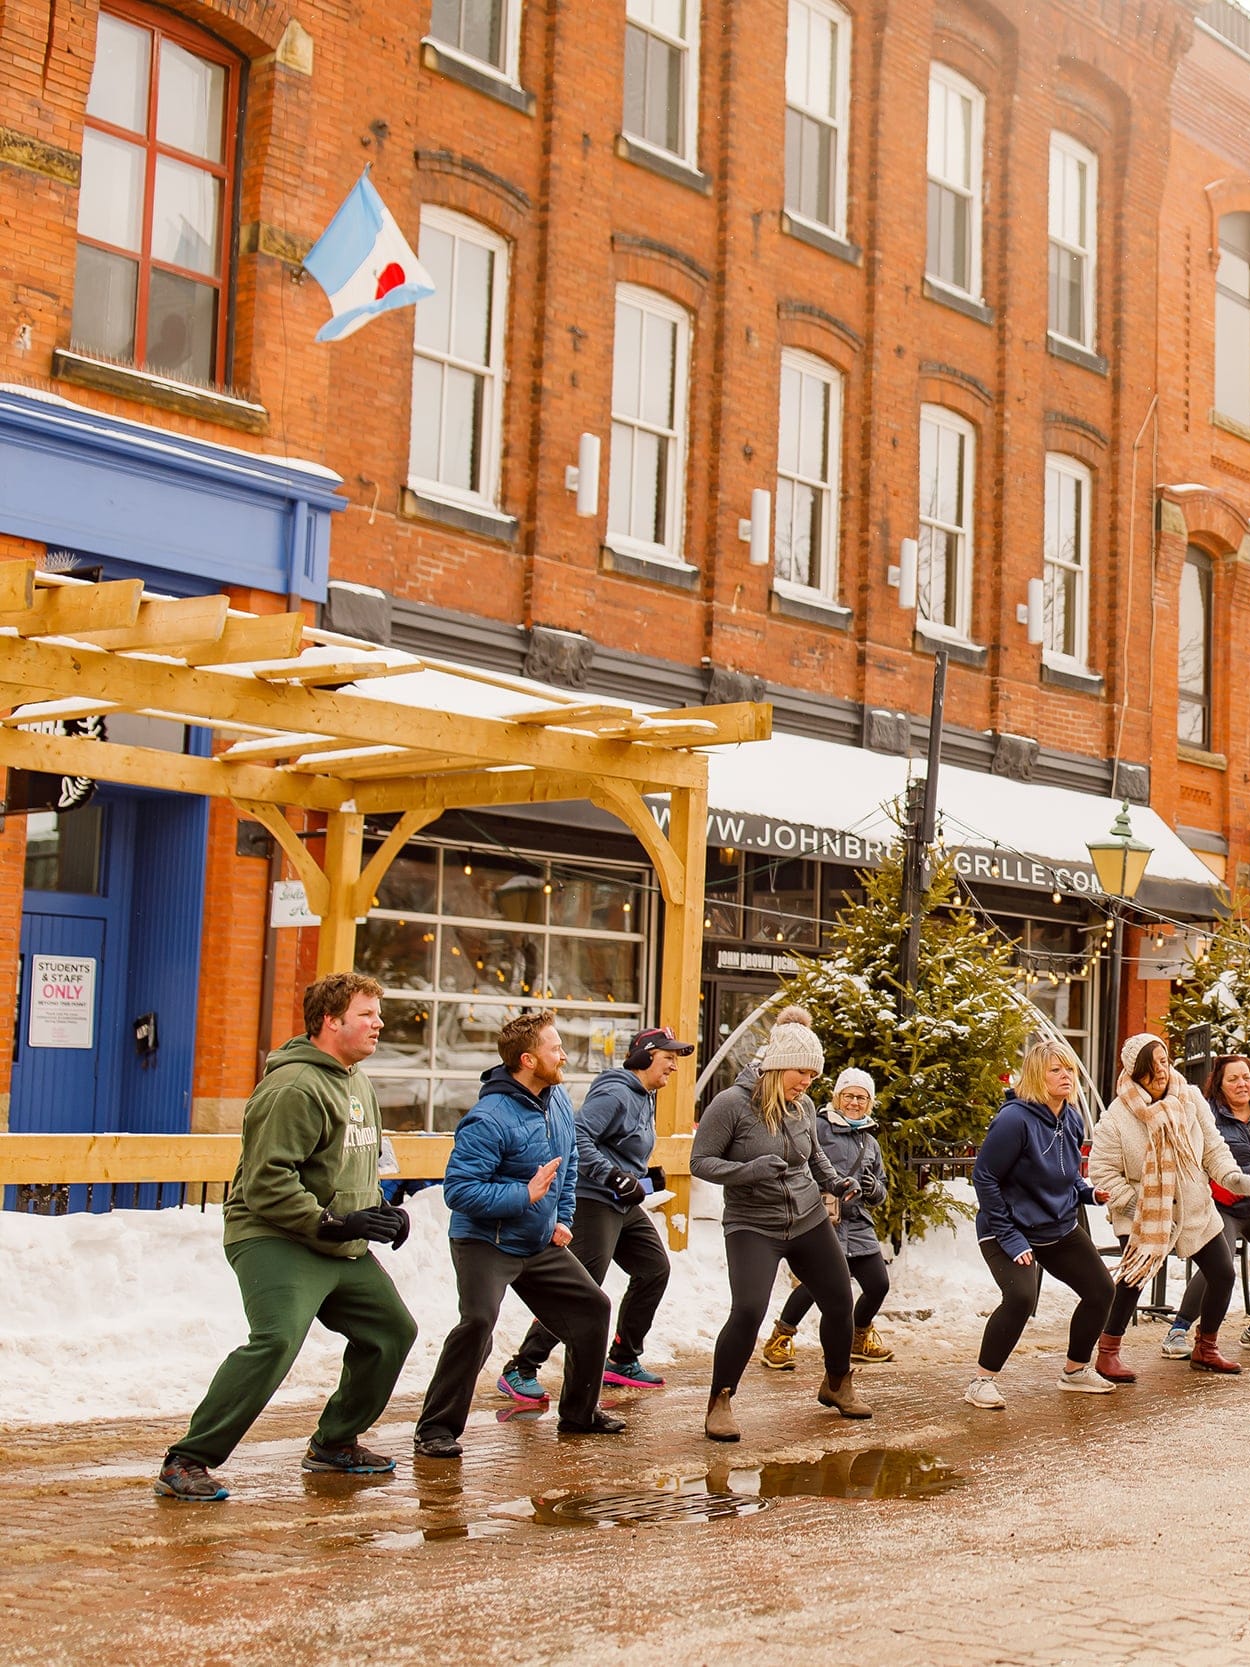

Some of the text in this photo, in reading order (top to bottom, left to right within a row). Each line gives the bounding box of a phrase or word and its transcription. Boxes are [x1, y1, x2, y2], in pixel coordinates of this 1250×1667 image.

[717, 950, 740, 968] JOHN
[740, 952, 772, 970] BROWN
[38, 962, 91, 974] STUDENTS
[41, 973, 84, 983] & STAFF
[42, 983, 84, 1000] ONLY
